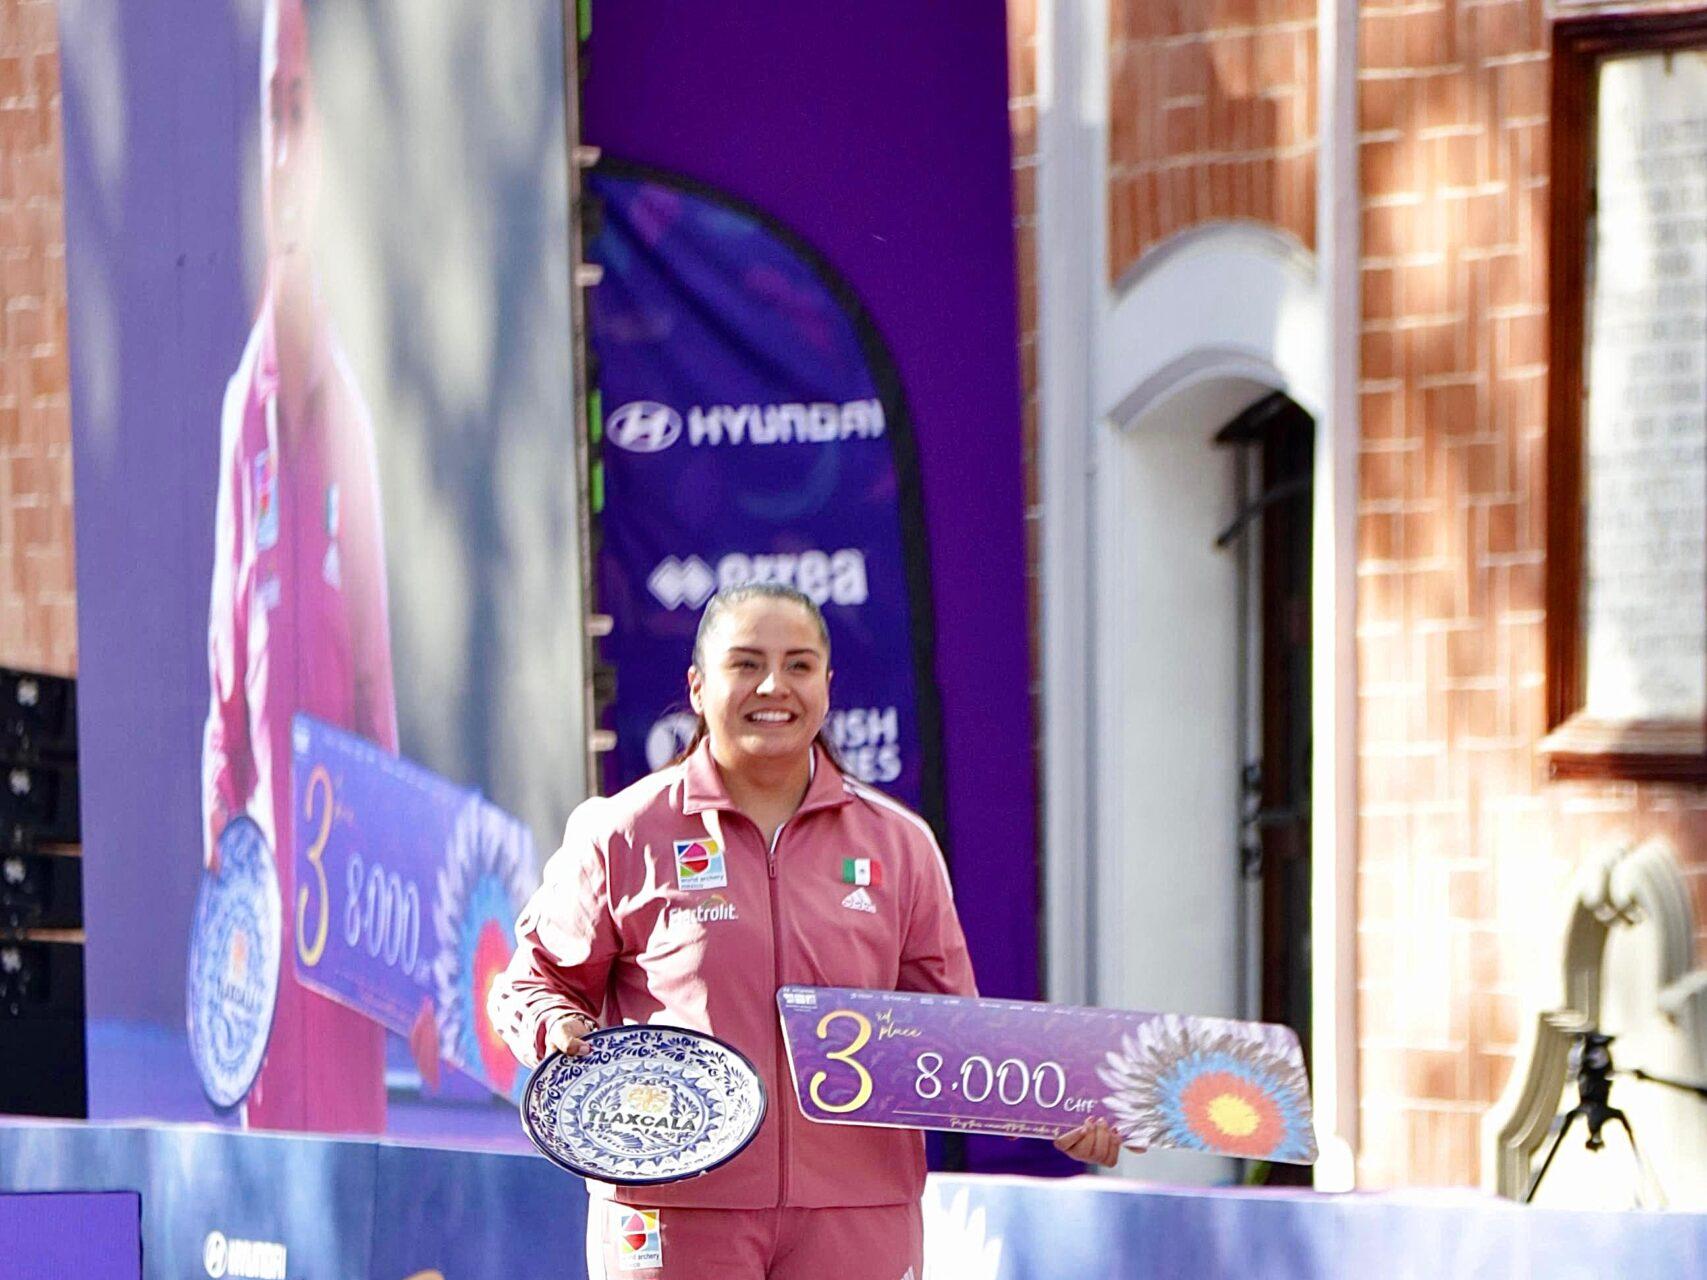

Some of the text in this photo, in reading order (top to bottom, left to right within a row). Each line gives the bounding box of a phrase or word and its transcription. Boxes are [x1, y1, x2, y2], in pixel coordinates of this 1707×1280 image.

[687, 399, 885, 446] HYUNDAI
[829, 706, 899, 747] ISH
[297, 763, 334, 967] 3
[809, 1010, 873, 1113] 3
[587, 1109, 696, 1132] TLAXCALA
